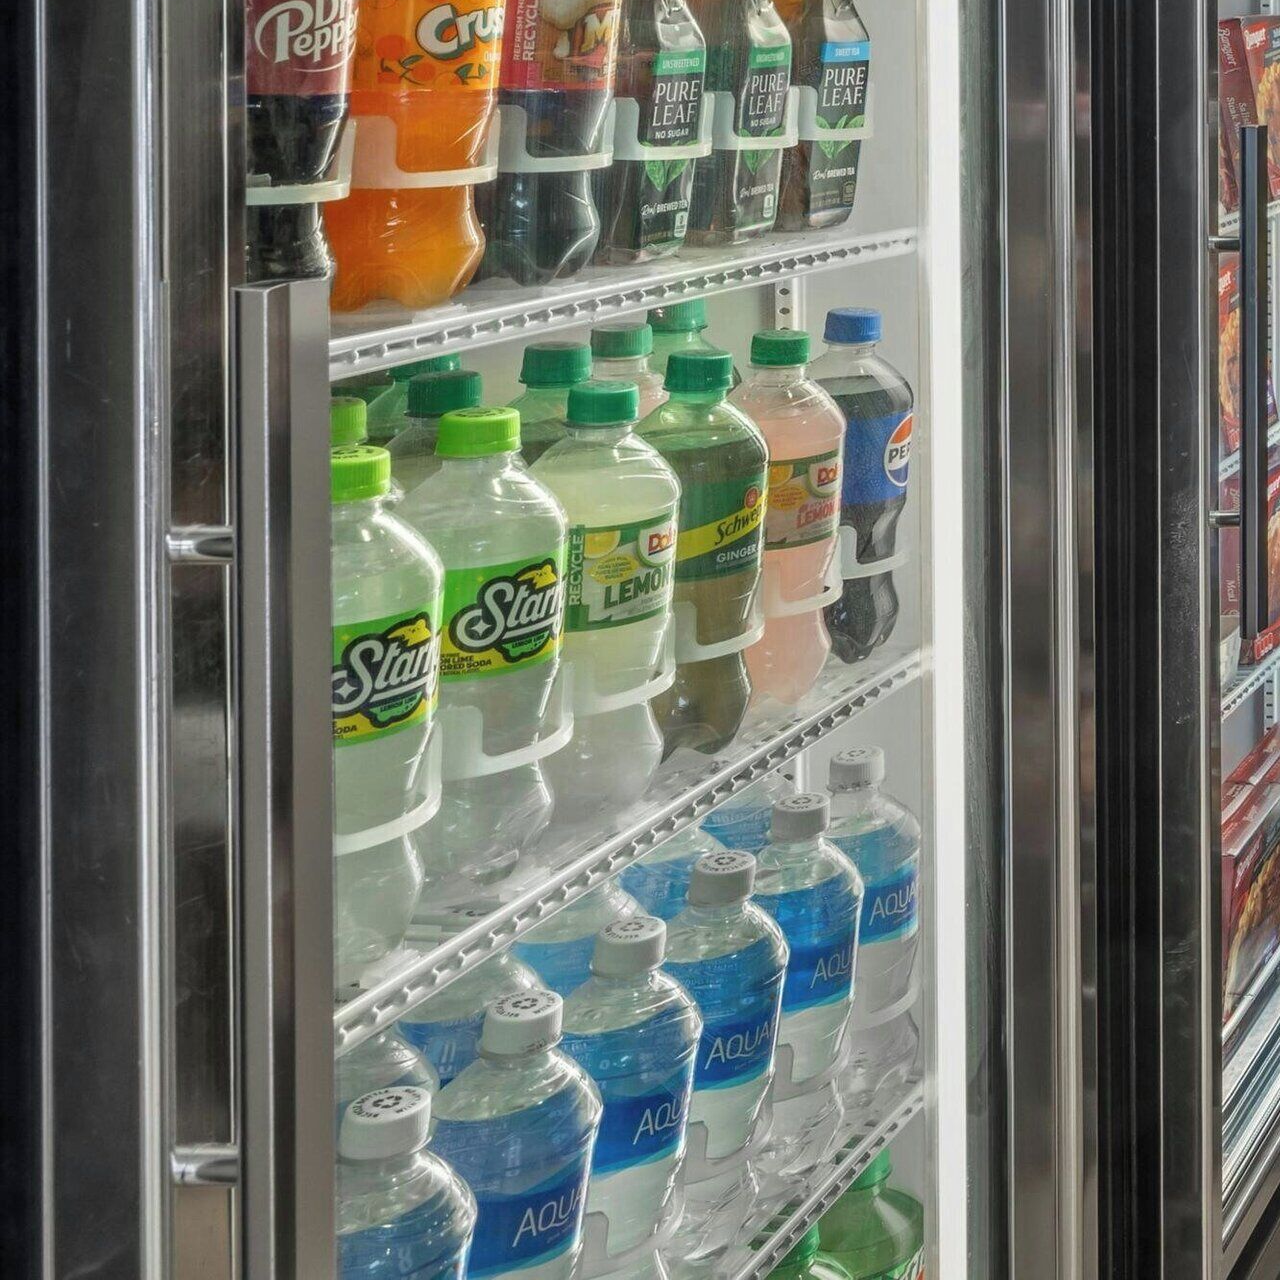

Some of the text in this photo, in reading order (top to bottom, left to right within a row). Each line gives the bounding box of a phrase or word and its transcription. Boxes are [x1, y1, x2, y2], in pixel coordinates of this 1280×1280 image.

[512, 22, 522, 61] REFRESH
[751, 72, 785, 93] PURE
[824, 67, 865, 89] PURE
[655, 80, 700, 104] PURE
[750, 118, 776, 128] NO SUGAR
[655, 128, 689, 140] NO SUGAR
[827, 167, 855, 178] BREWED TEA
[656, 200, 688, 214] BREWED TEA
[568, 534, 582, 605] RECYCLE
[452, 655, 475, 664] LIME
[466, 658, 492, 669] SODA
